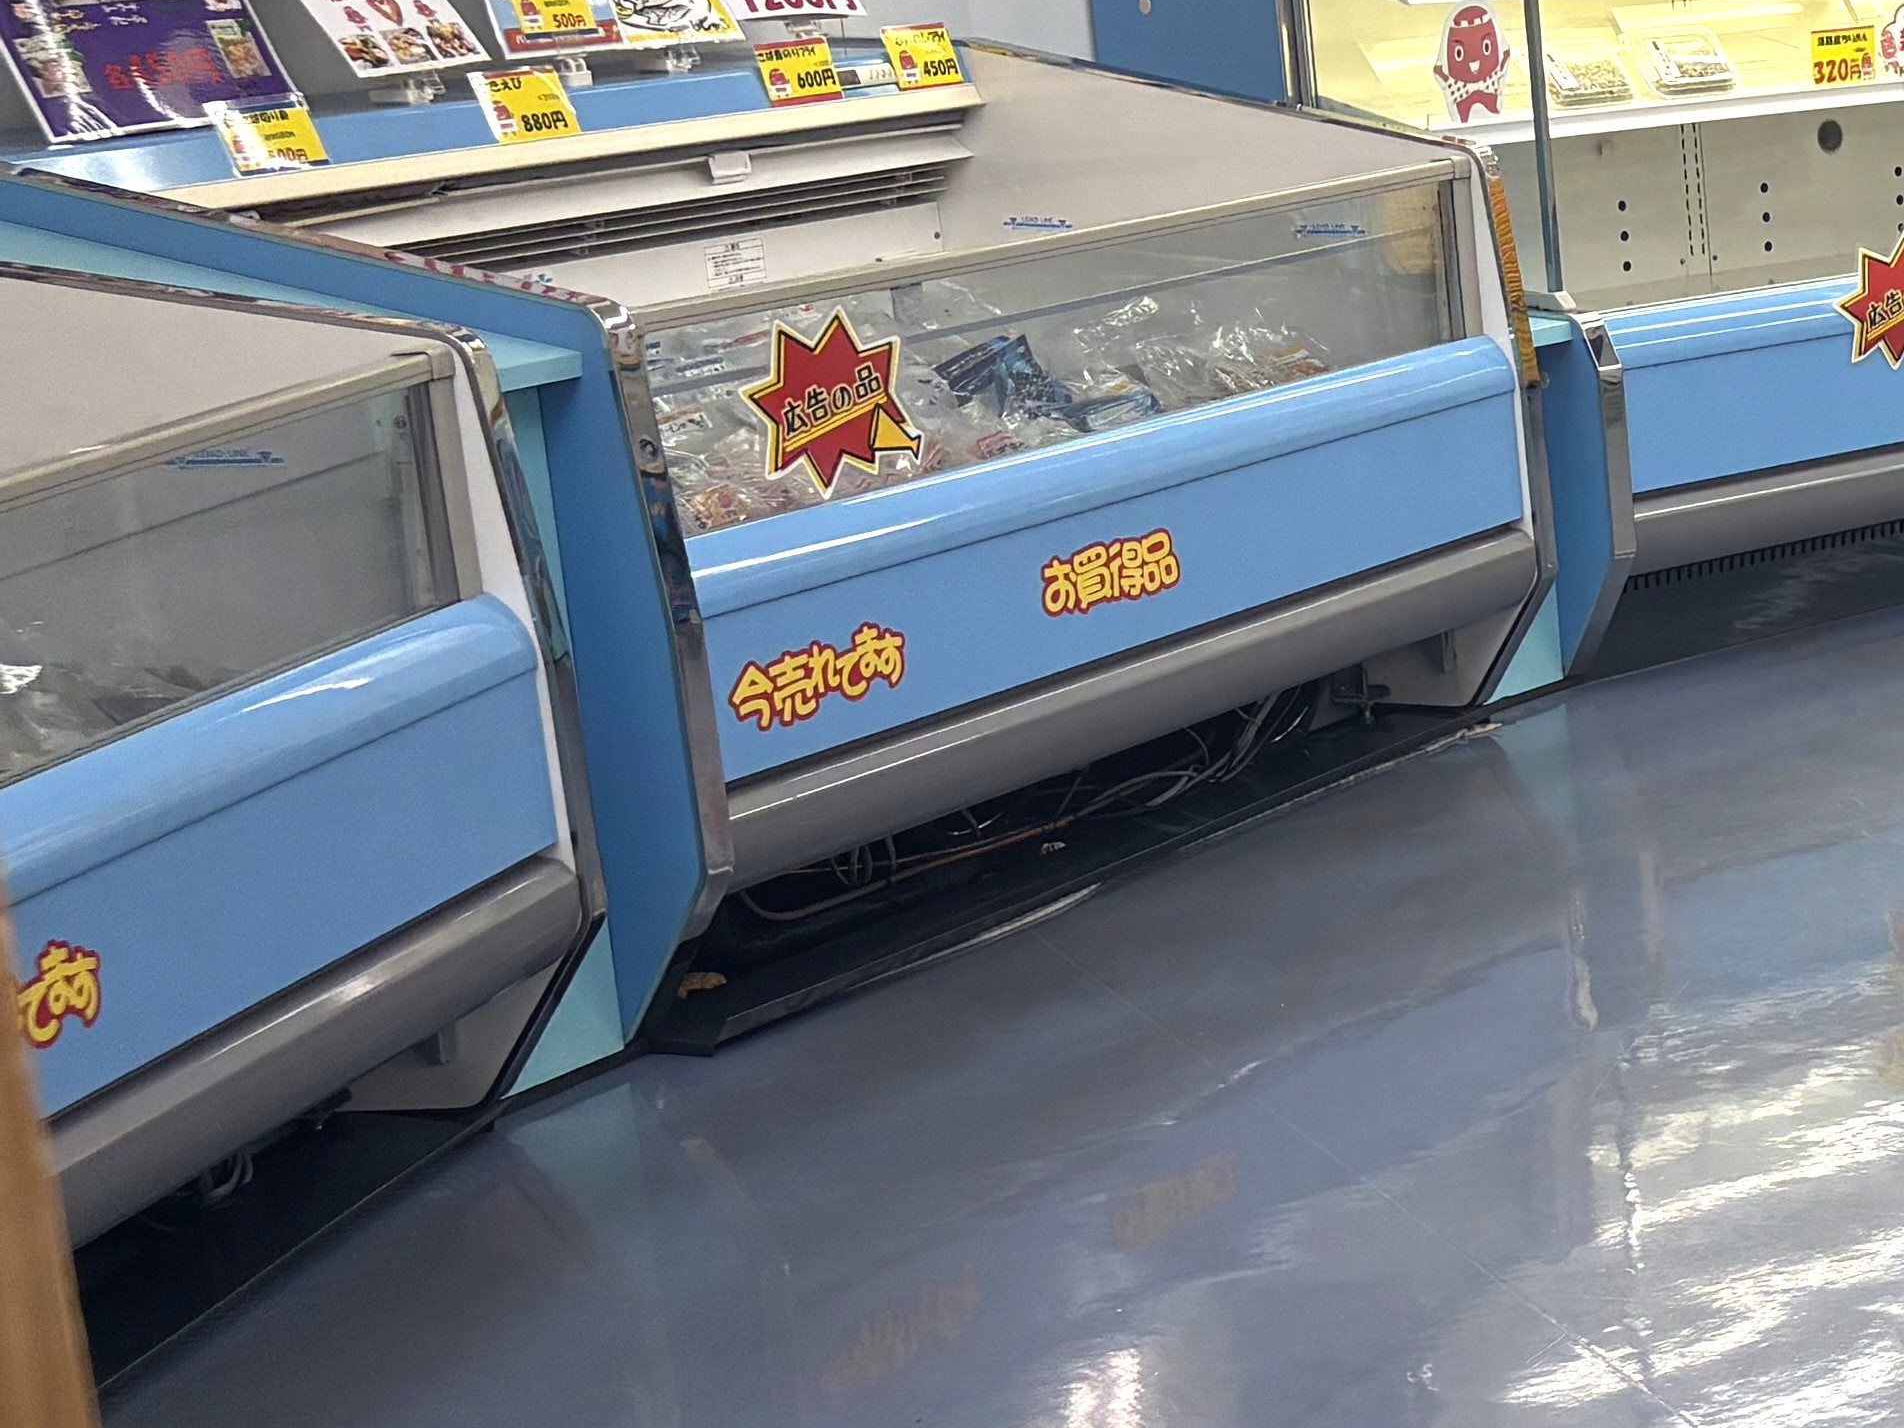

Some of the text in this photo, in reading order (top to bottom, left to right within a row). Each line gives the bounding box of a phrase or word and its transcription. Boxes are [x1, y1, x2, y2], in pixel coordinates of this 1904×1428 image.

[552, 12, 587, 29] 500円
[796, 67, 837, 90] 600円
[923, 57, 959, 78] 450円
[1813, 56, 1862, 85] 320円
[487, 75, 523, 93] きえび
[520, 109, 570, 134] 880円
[782, 362, 883, 438] 広告の品
[1042, 528, 1180, 616] お買得品
